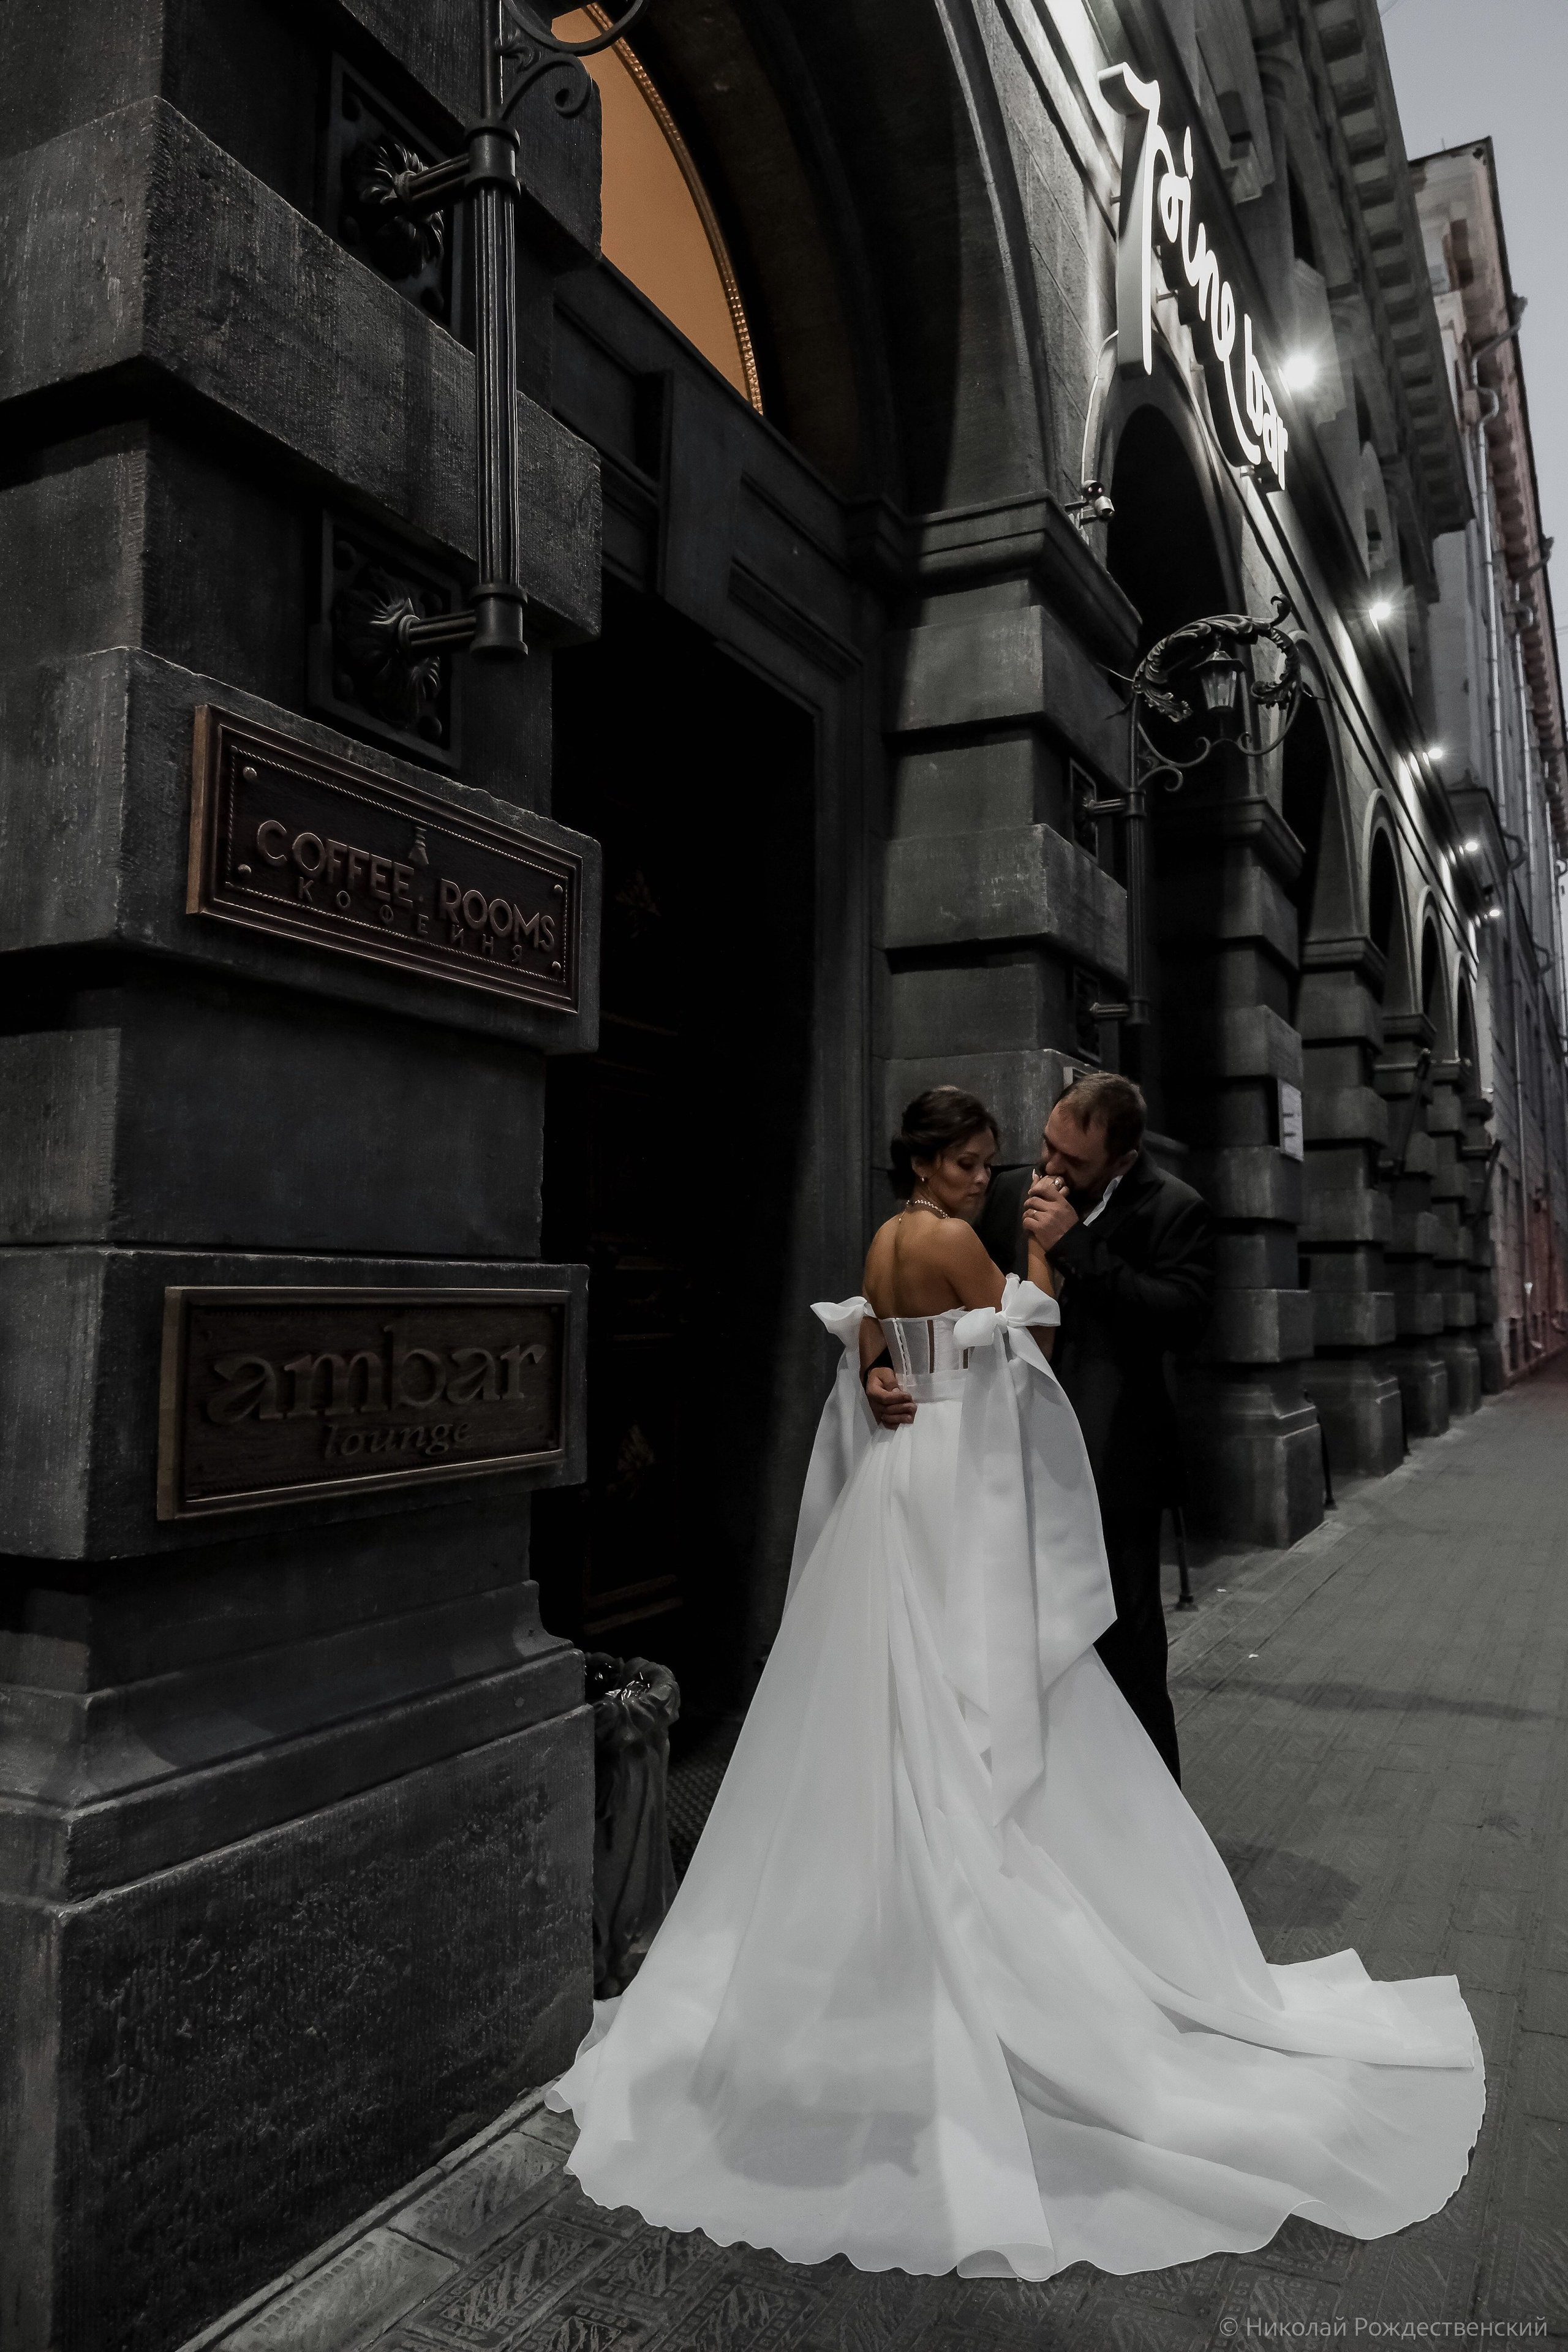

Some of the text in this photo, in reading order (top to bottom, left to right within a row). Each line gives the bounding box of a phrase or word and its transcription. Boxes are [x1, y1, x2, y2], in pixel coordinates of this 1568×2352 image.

[1244, 313, 1287, 491] bar
[256, 820, 555, 952] COFFEE ROOMS
[294, 876, 523, 963] КОФЕЙНЯ
[205, 1325, 548, 1425] ambar
[323, 1420, 470, 1460] lounge
